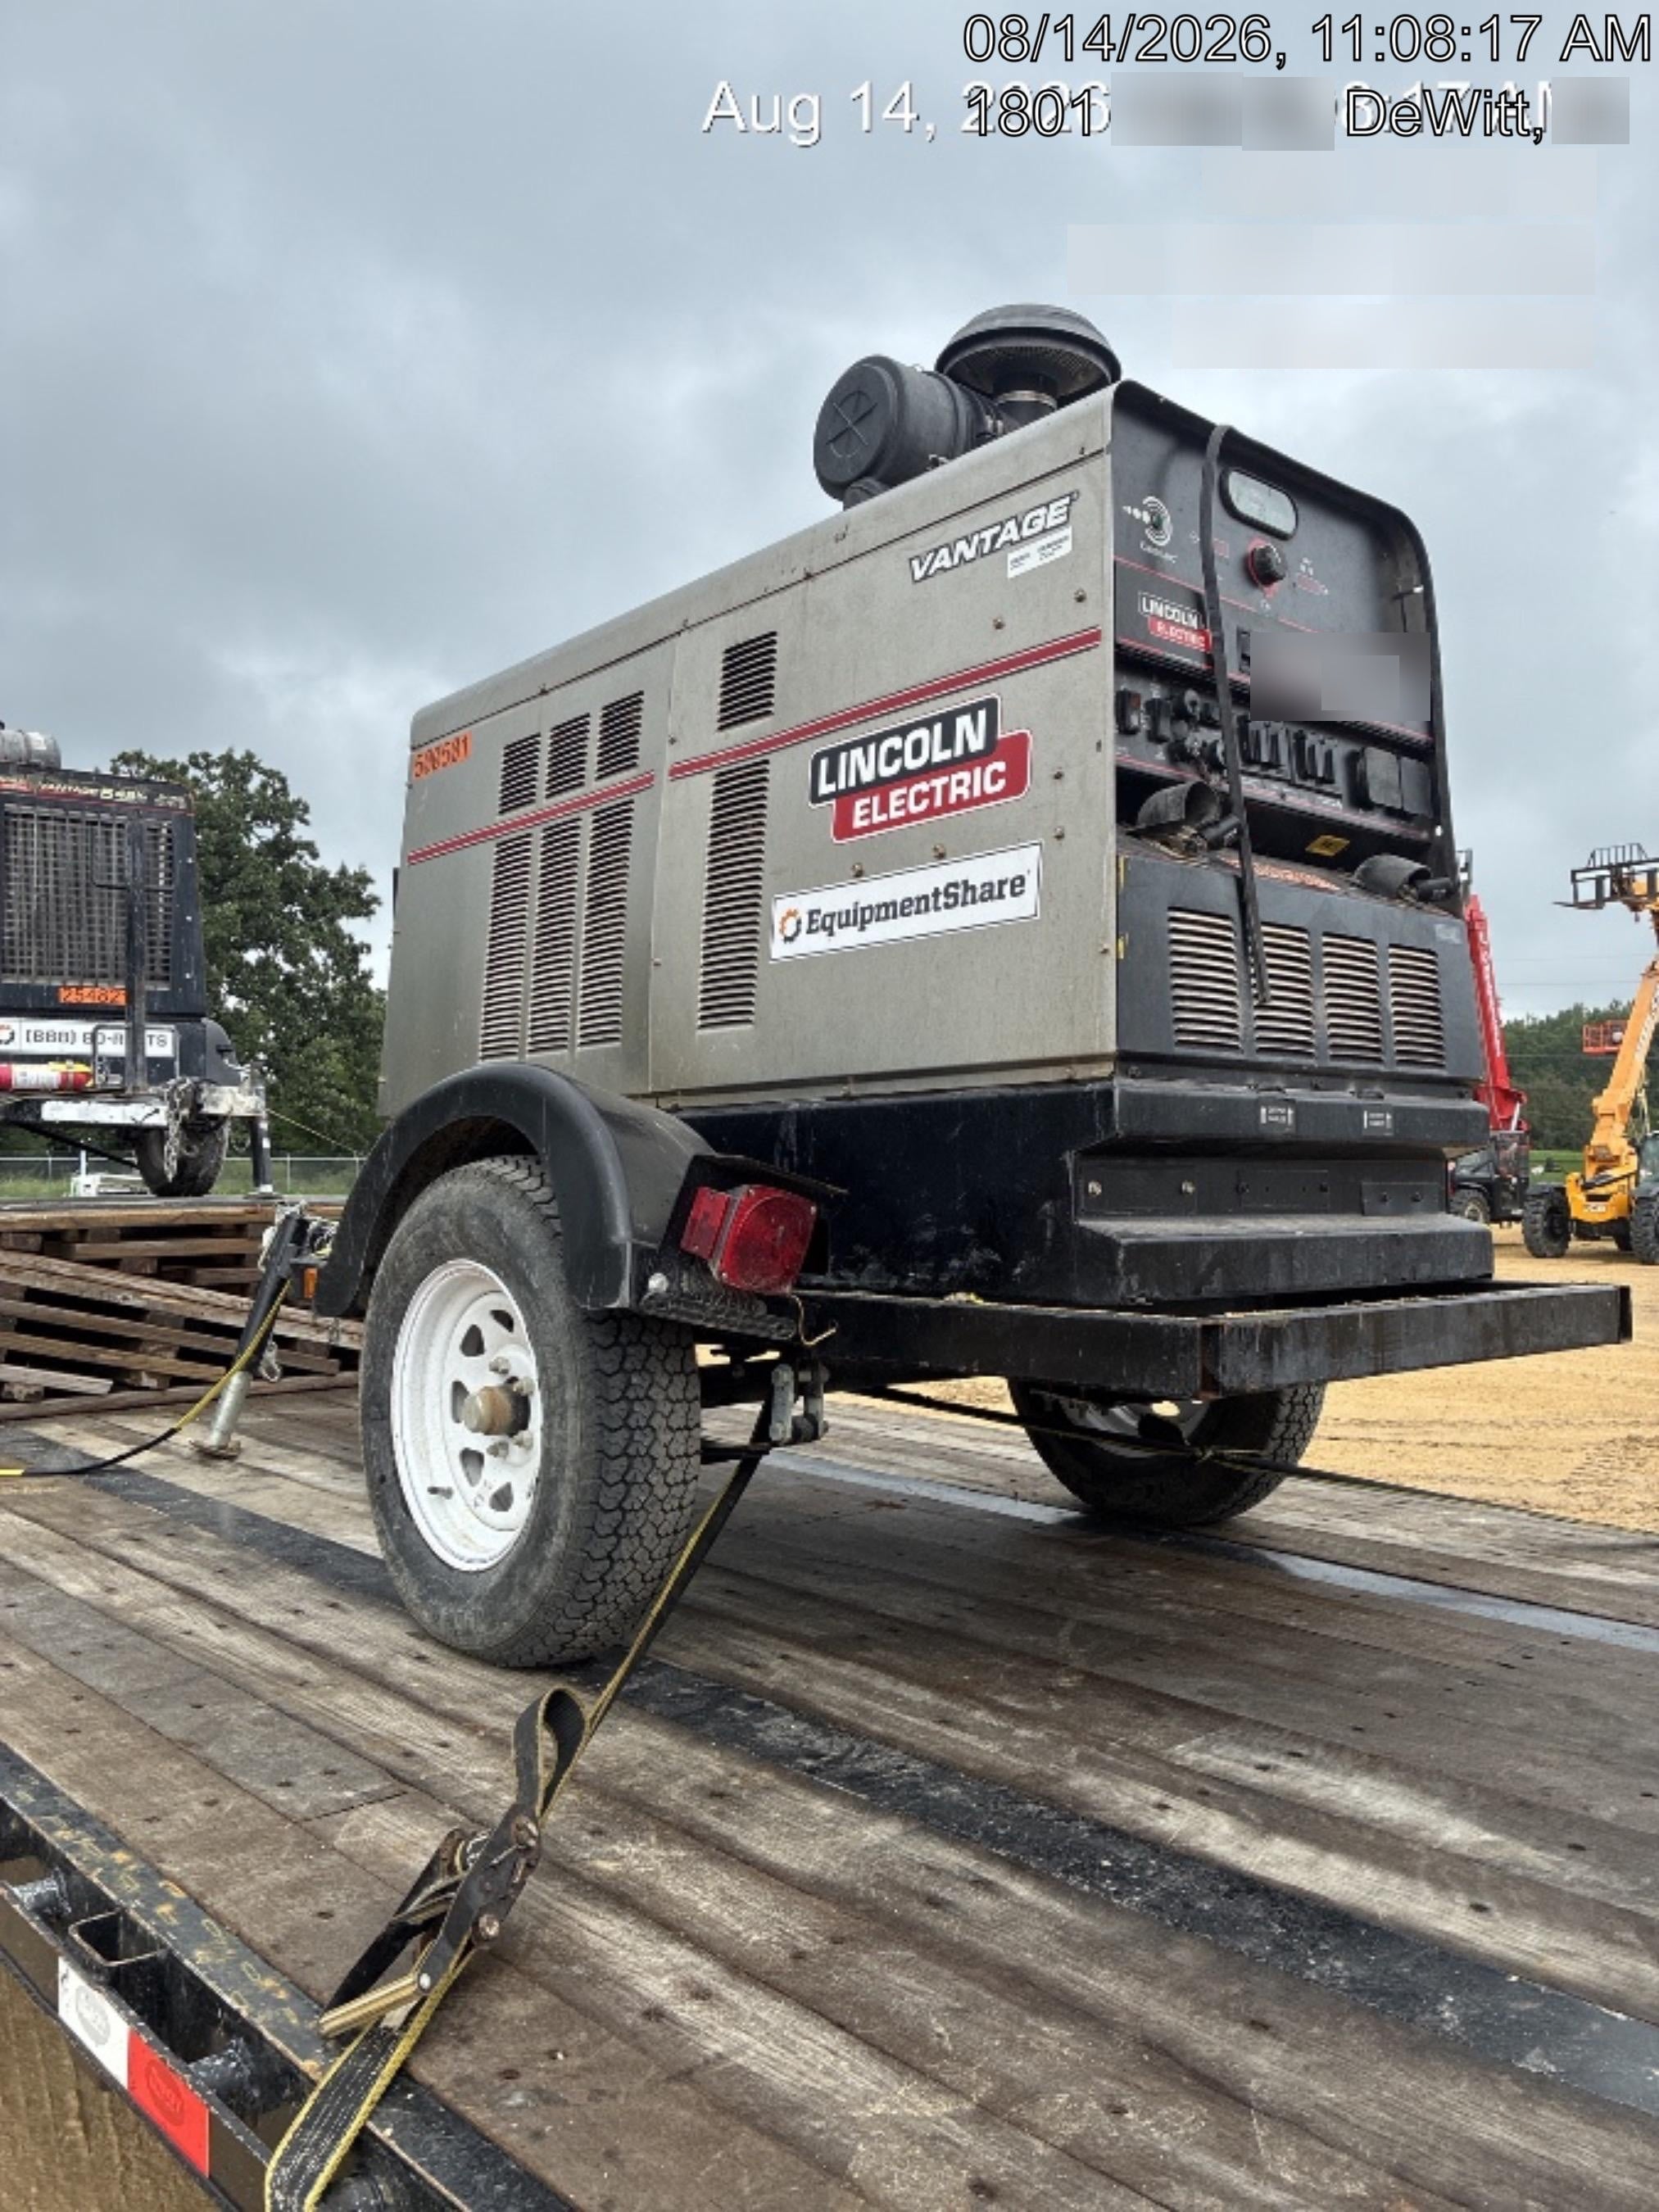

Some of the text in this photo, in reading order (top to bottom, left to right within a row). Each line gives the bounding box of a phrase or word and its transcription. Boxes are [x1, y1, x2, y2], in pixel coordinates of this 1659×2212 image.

[909, 492, 1074, 583] VANTAGE
[1141, 596, 1199, 630] LINCOLN
[818, 707, 988, 797] LINCOLN
[851, 760, 1008, 830] ELECTRIC
[805, 872, 1027, 937] EquipmentShare
